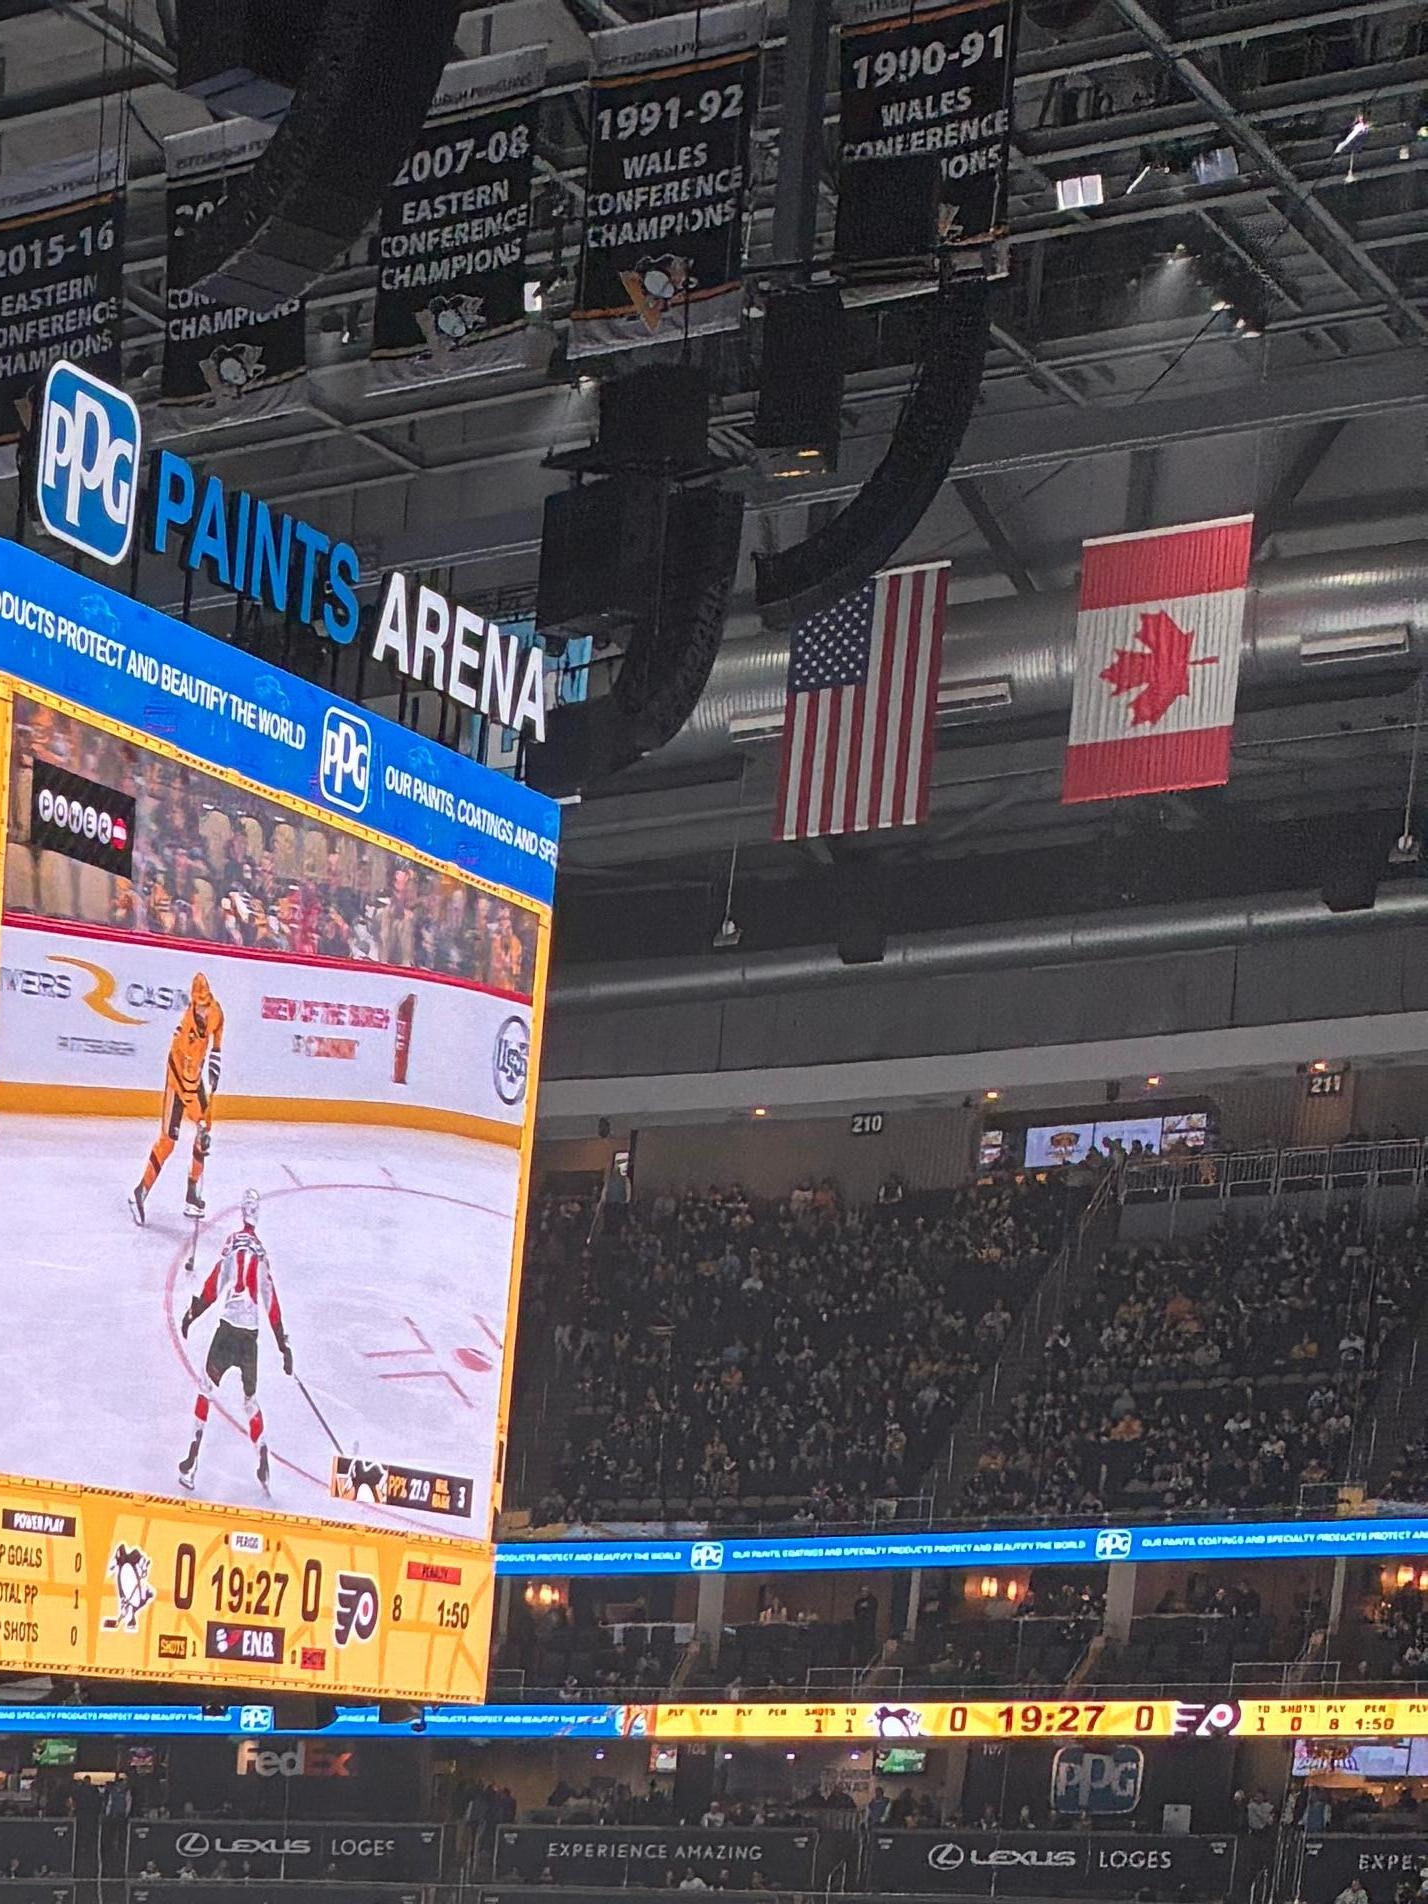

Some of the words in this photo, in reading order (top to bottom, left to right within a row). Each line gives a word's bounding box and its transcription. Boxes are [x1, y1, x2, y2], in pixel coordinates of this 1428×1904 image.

[853, 24, 1005, 89] 1990-91
[597, 84, 744, 141] 1991-92
[881, 86, 972, 127] WALES
[394, 124, 530, 187] 2007-08
[844, 108, 1009, 160] CONFERENCE
[623, 142, 708, 180] WALES
[402, 178, 509, 225] EASTERN
[588, 165, 743, 218] CONFERENCE
[381, 204, 528, 259] CONFERENCE
[588, 200, 736, 248] CHAMPIONS
[381, 238, 522, 290] CHAMPIONS
[1, 270, 98, 317] EASTERN
[156, 450, 360, 643] PAINTS
[373, 571, 545, 742] ARENA
[57, 616, 126, 671] PROTECT
[126, 649, 159, 685] AND
[161, 663, 229, 716] BEAUTIFY
[229, 694, 258, 729] THE
[258, 707, 306, 751] WORLD
[384, 765, 412, 800] OUR
[413, 779, 456, 823] PAINTS,
[457, 799, 514, 844] COATINGS
[513, 825, 538, 855] AND
[38, 789, 112, 844] POWER
[1310, 1074, 1341, 1096] 211
[852, 1113, 883, 1134] 210
[174, 1543, 196, 1610] 0
[211, 1564, 288, 1619] 19:27
[301, 1559, 322, 1622] 0
[393, 1594, 402, 1622] 8
[437, 1600, 469, 1630] 1:50
[949, 1706, 968, 1732] 0
[998, 1705, 1105, 1733] 19:27
[1135, 1706, 1154, 1732] 0
[1355, 1718, 1394, 1731] 1:50
[236, 1740, 352, 1776] FedEx
[215, 1838, 311, 1854] LEXUS
[548, 1843, 667, 1859] EXPERIENCE
[675, 1844, 763, 1860] AMAZING
[971, 1849, 1076, 1866] LEXUS
[1099, 1850, 1172, 1869] LOGES
